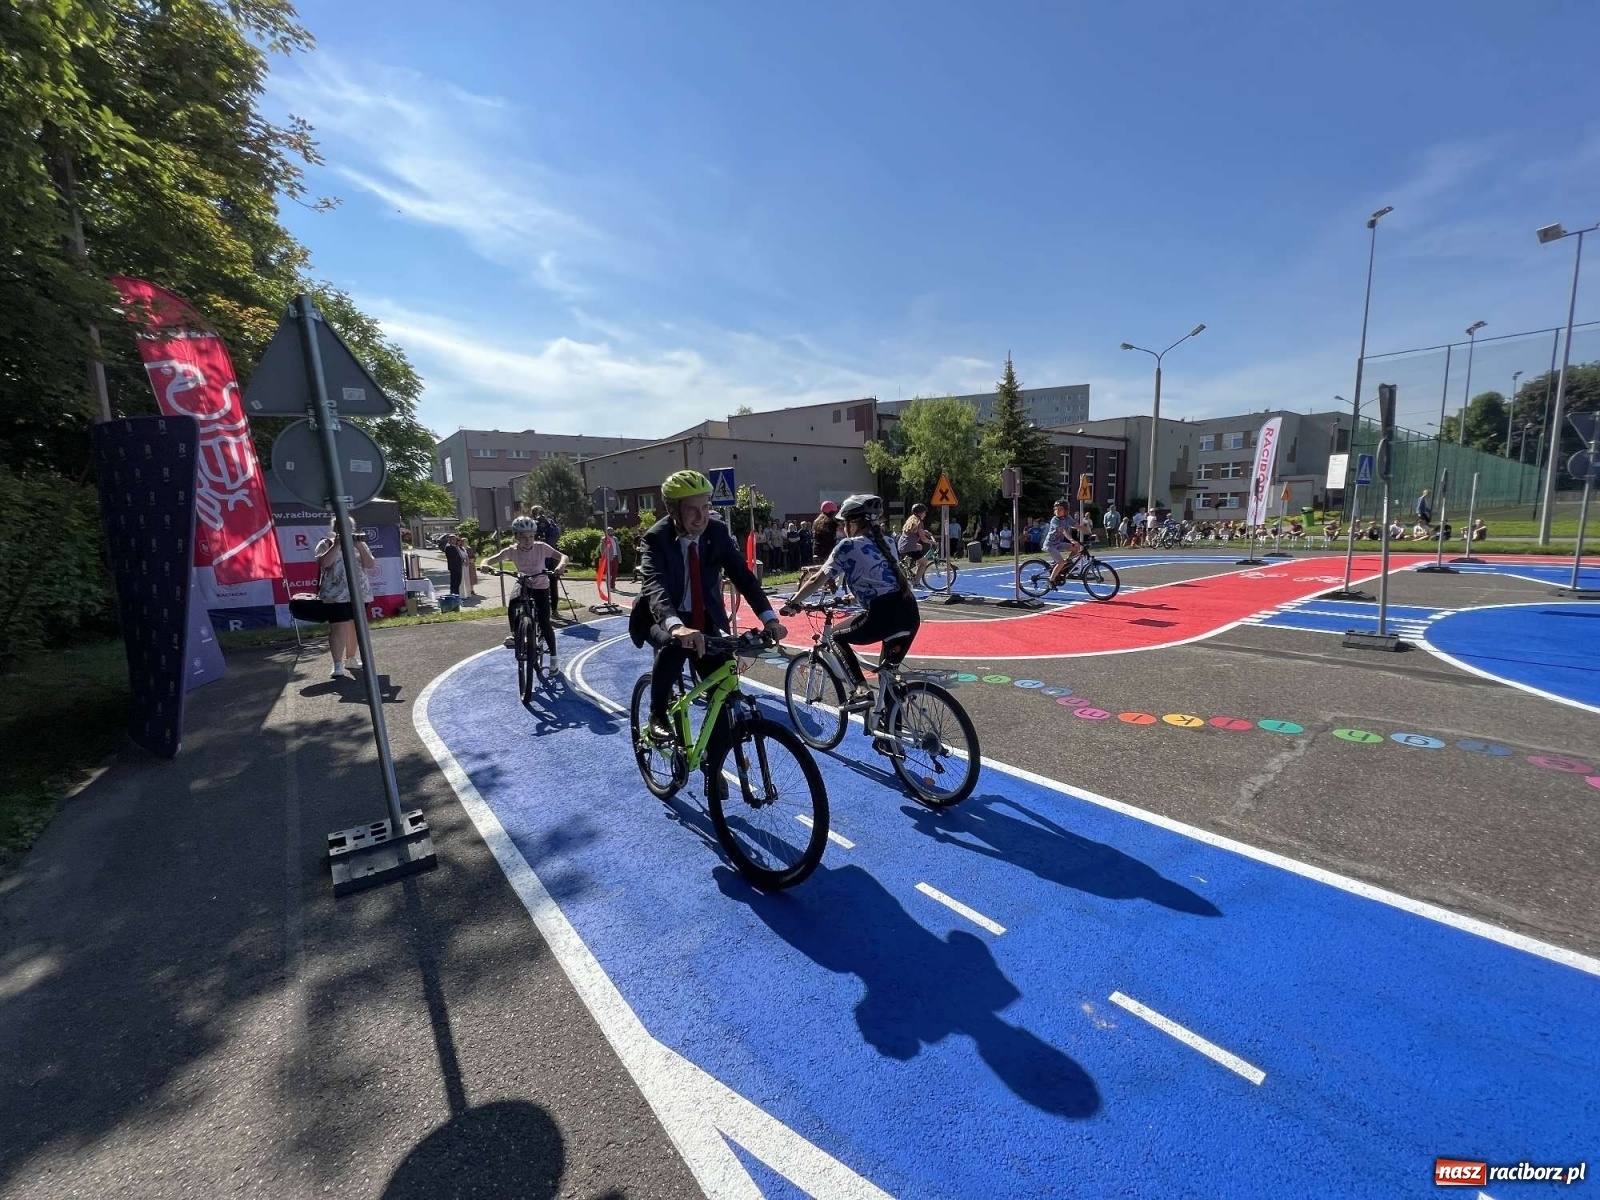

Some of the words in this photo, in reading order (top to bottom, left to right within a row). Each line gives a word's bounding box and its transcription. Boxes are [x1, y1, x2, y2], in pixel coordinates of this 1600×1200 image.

[295, 534, 308, 546] R
[282, 578, 318, 587] RACIBÓ
[371, 607, 384, 618] R
[229, 619, 243, 632] R
